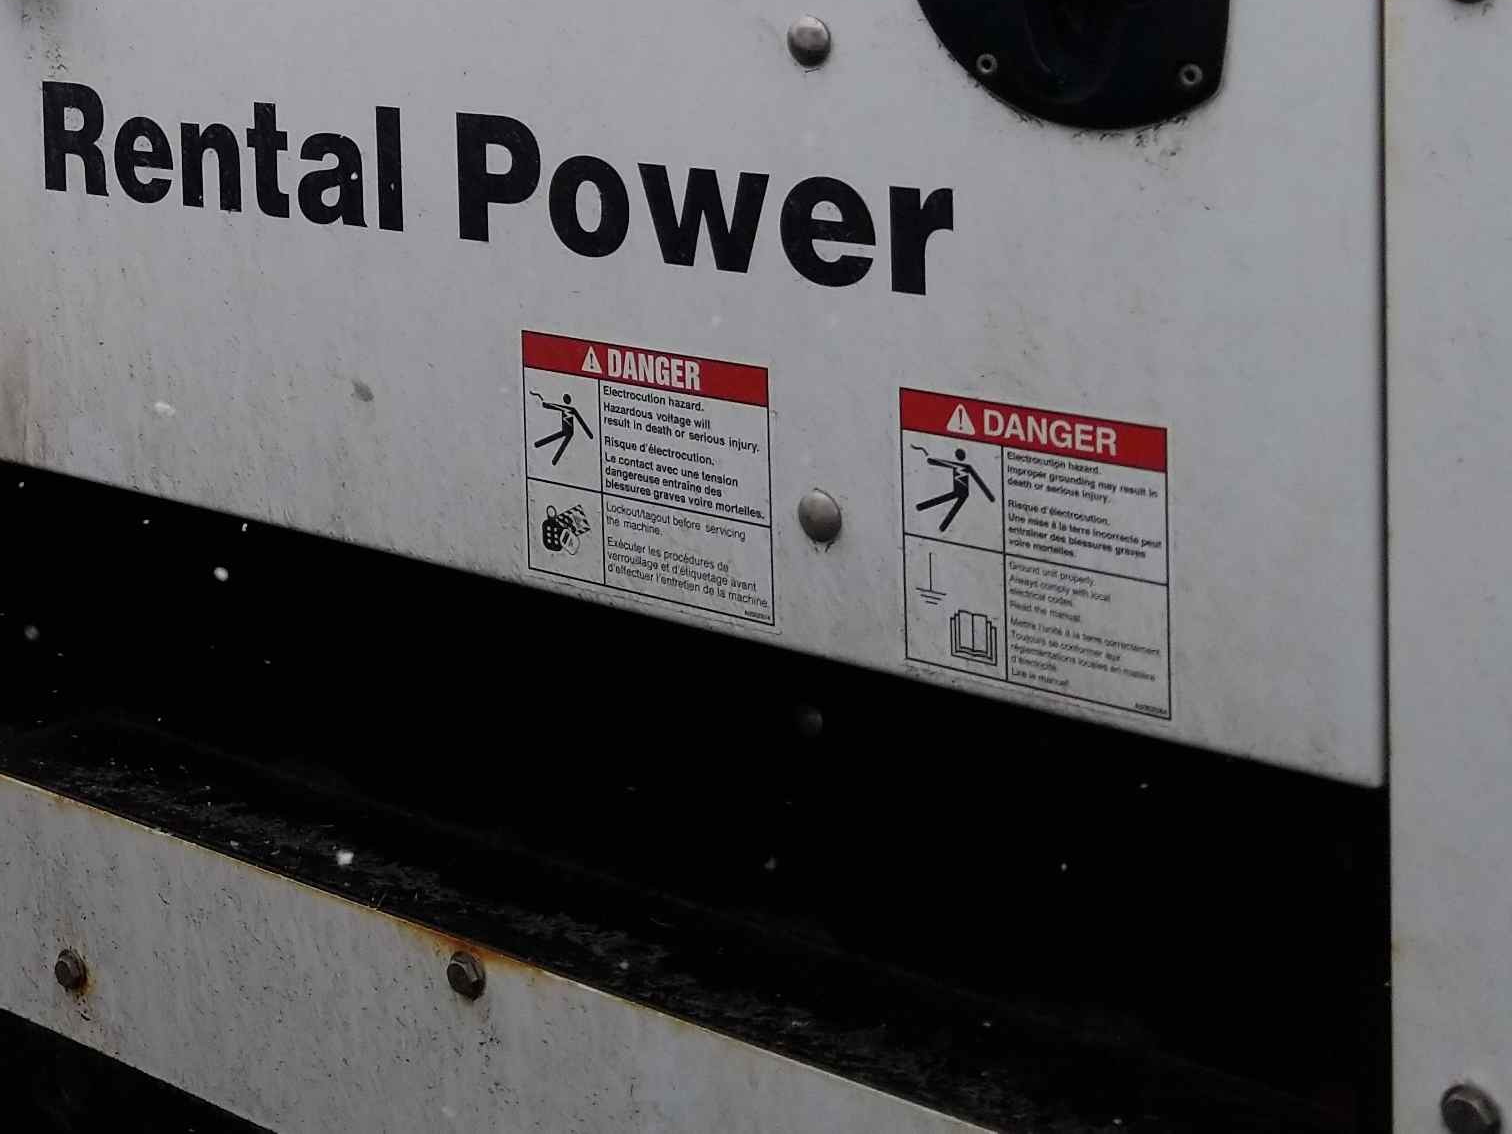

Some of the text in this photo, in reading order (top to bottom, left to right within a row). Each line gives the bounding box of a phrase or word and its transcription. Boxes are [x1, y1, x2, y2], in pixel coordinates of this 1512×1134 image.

[41, 80, 955, 295] Rental Power
[607, 348, 701, 391] DANGER
[603, 385, 705, 412] Electrocution hazard.
[603, 402, 710, 429] Hazardous voltage will
[983, 408, 1117, 456] DANGER
[603, 416, 760, 453] result in death or serious injury.
[604, 435, 637, 452] Risque
[604, 452, 739, 486] Le contact avec une tension
[605, 465, 660, 485] dangereuse
[704, 485, 722, 498] des
[605, 478, 652, 497] blessures
[688, 496, 713, 509] voire
